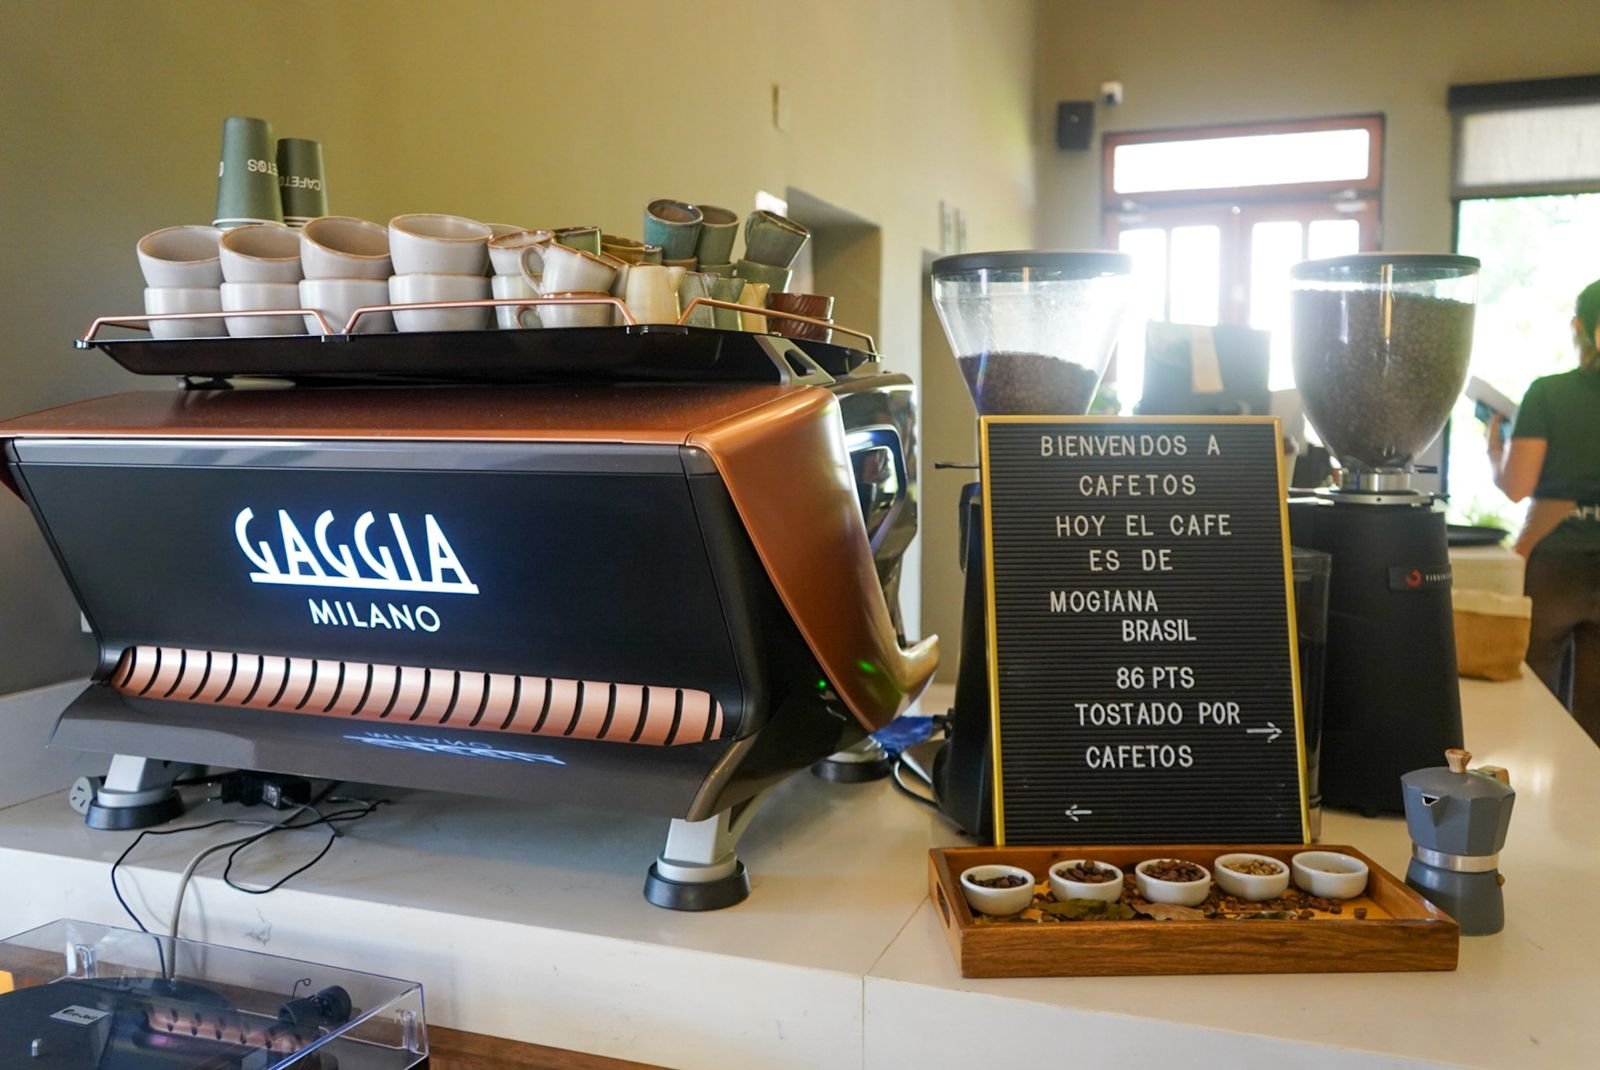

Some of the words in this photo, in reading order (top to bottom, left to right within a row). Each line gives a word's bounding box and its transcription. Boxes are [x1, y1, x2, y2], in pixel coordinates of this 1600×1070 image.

[1041, 434, 1188, 458] BIENVENDOS
[1207, 434, 1221, 456] A
[1079, 473, 1197, 497] CAFETOS
[1056, 514, 1106, 538] HOY
[1126, 514, 1155, 536] EL
[1169, 513, 1233, 537] CAFE
[234, 506, 480, 595] GAGGIA
[1089, 549, 1121, 571] ES
[1142, 549, 1174, 571] DE
[1050, 590, 1159, 613] MOGIANA
[308, 598, 441, 633] MILANO
[1122, 619, 1198, 642] BRASIL
[1116, 667, 1145, 689] 86
[1152, 667, 1196, 689] PTS
[1074, 703, 1184, 726] TOSTADO
[1199, 702, 1241, 725] POR
[1086, 745, 1194, 769] CAFETOS
